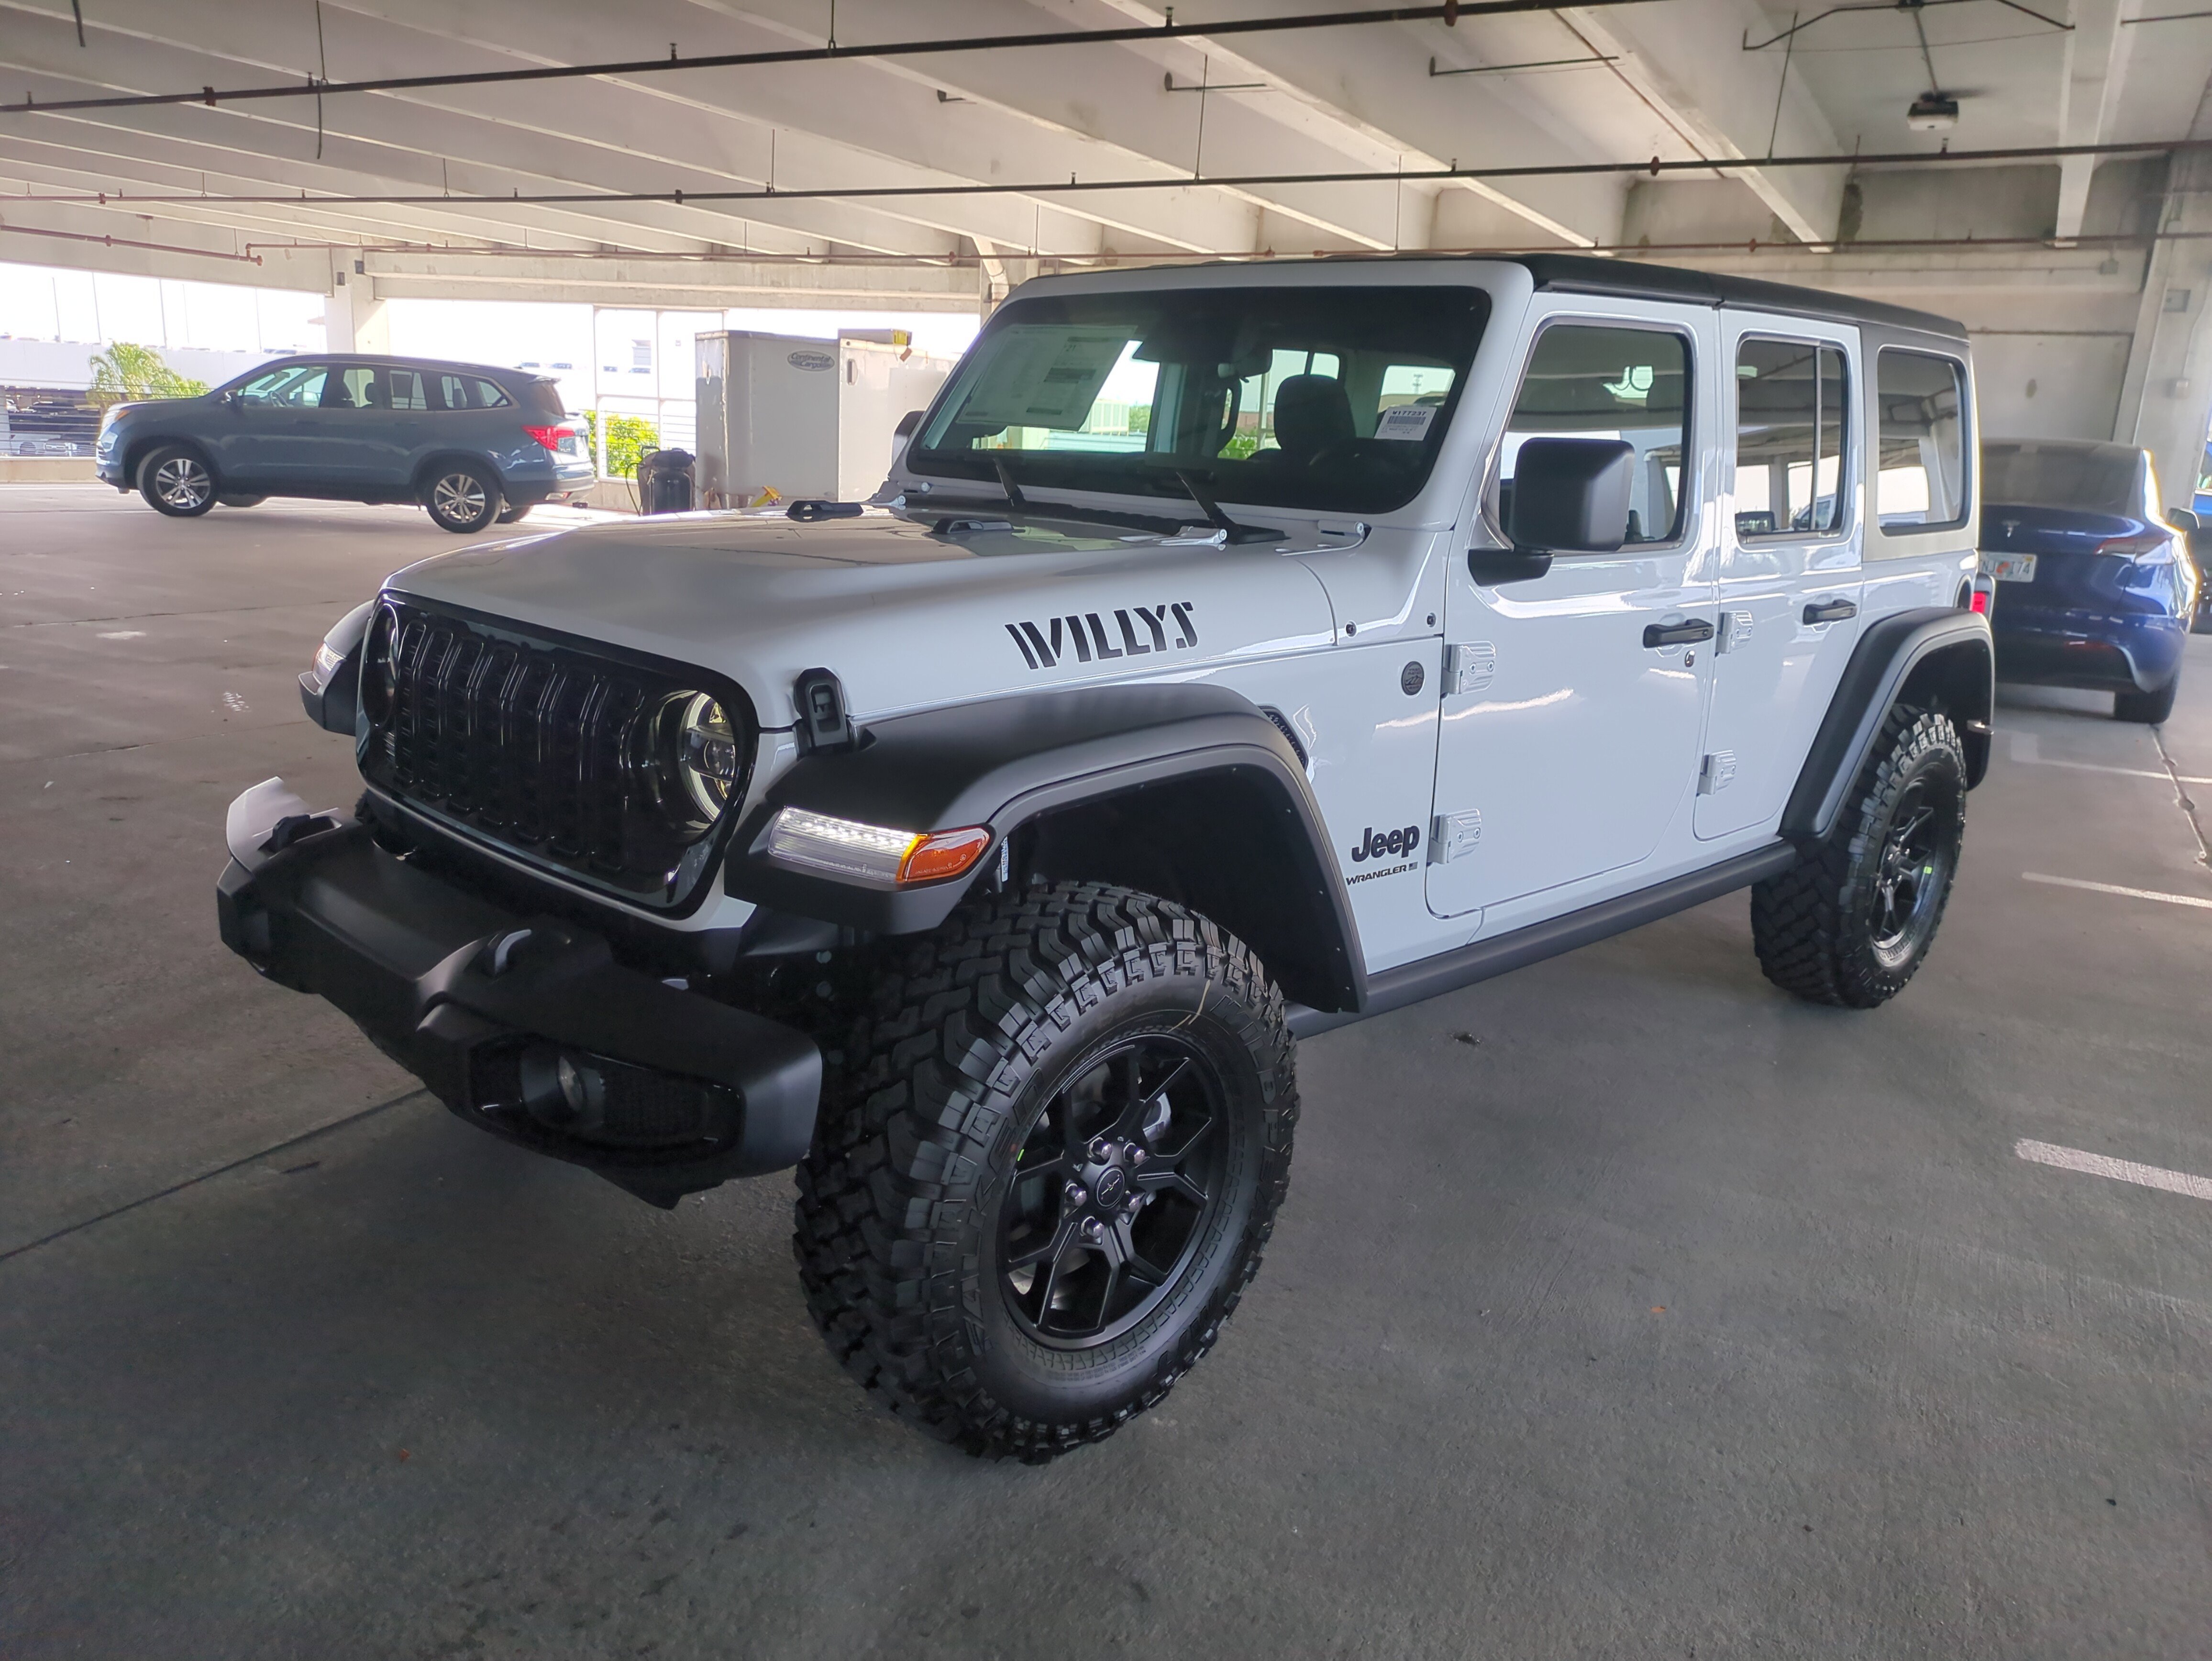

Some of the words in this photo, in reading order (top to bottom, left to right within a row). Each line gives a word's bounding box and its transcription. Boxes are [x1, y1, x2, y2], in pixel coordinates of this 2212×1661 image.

[791, 352, 831, 363] Continental
[800, 361, 821, 369] Cargo
[1004, 601, 1199, 670] WILLYS
[1351, 825, 1420, 863] Jeep
[1345, 864, 1407, 886] WRANGLER
